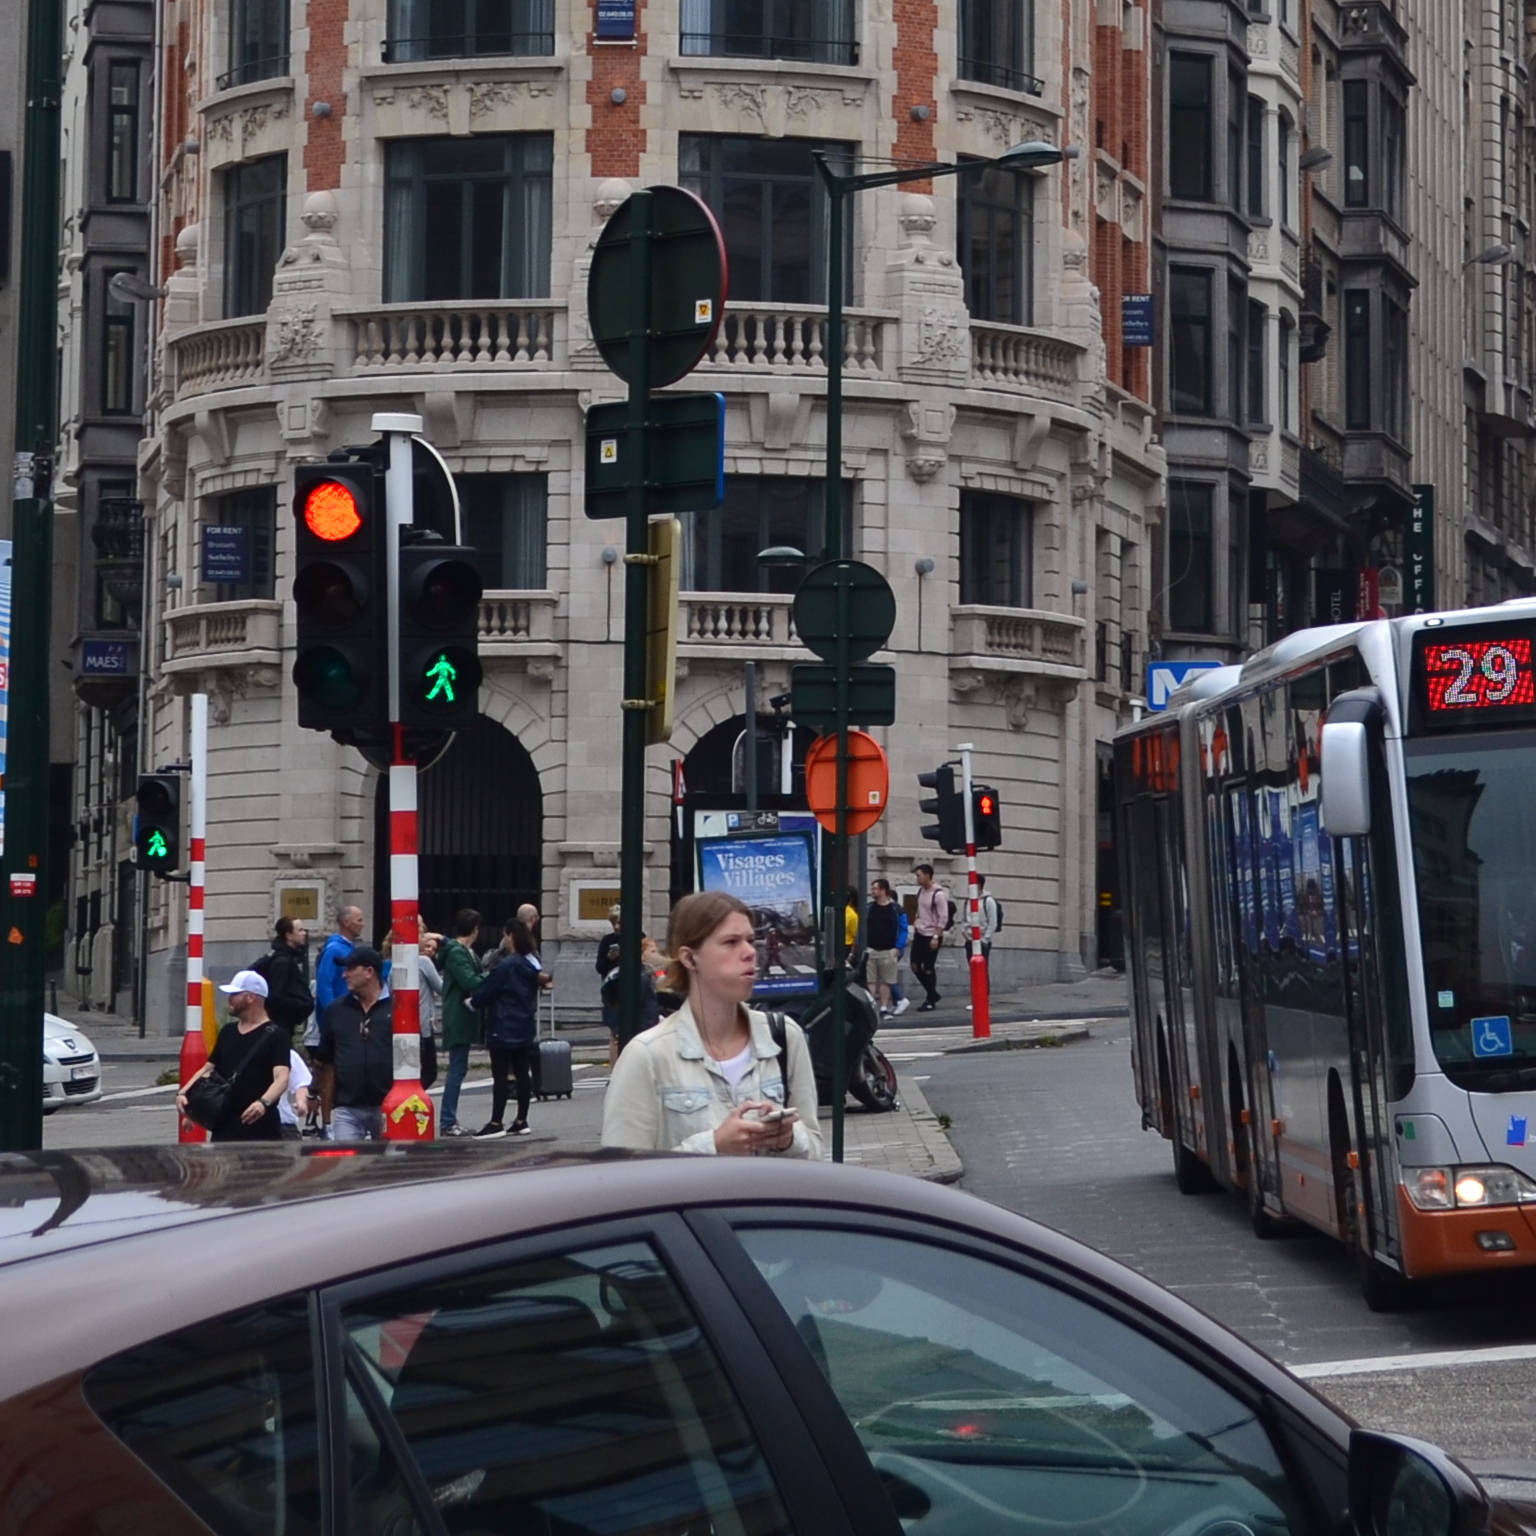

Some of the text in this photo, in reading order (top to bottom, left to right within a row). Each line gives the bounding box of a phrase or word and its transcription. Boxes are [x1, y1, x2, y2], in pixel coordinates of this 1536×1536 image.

[86, 655, 120, 669] MAES
[1441, 646, 1518, 704] 29
[716, 852, 786, 873] Visages
[722, 870, 796, 891] Villages
